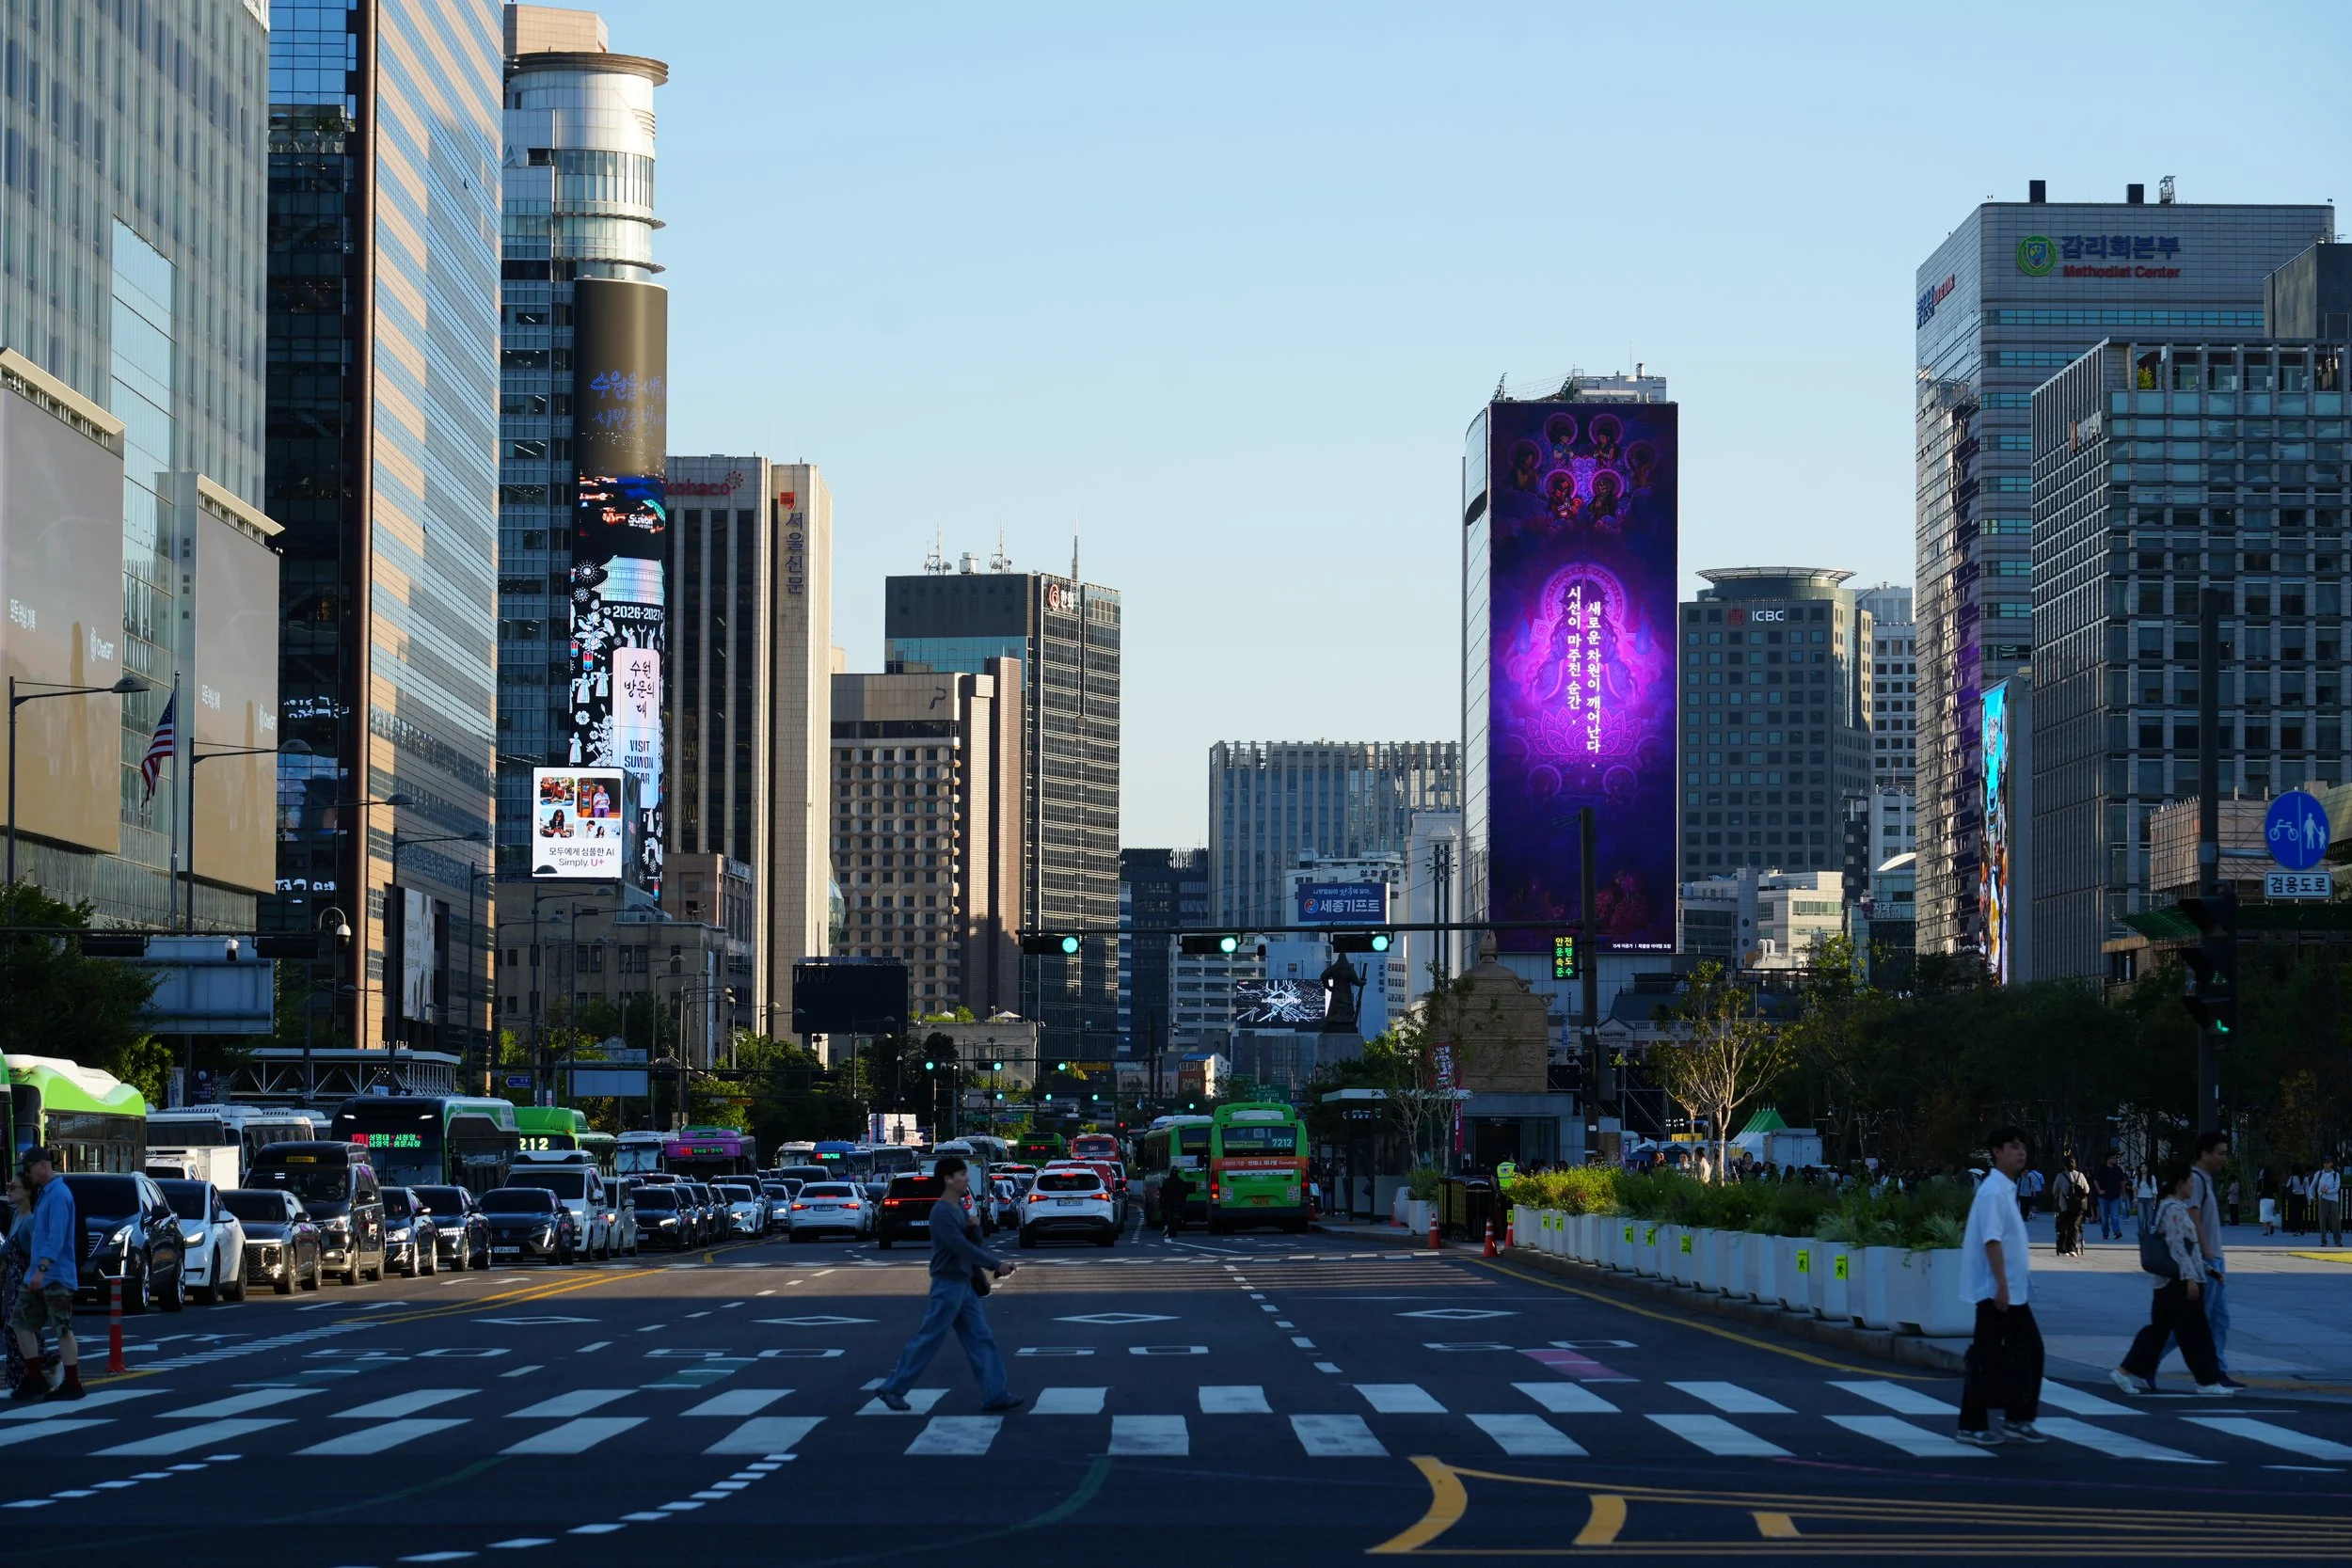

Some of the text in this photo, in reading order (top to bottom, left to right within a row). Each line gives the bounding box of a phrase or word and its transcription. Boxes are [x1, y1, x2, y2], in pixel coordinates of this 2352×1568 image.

[2061, 235, 2181, 260] 감리회본부
[2063, 265, 2181, 278] Methodist Center
[666, 479, 731, 496] kobaco
[786, 512, 804, 594] 서울신문
[1060, 590, 1074, 610] 한화
[612, 605, 660, 621] 2026-2027
[1752, 610, 1784, 622] ICBC
[1586, 601, 1601, 645] 새로운
[97, 638, 115, 660] ChatGPT
[1567, 586, 1581, 724] 시선이 마주친 순간,
[629, 660, 651, 679] 수원
[1586, 648, 1601, 692] 차원이
[624, 679, 655, 699] 방문의
[629, 739, 650, 752] VISIT
[624, 755, 654, 769] SUWON
[548, 847, 580, 857] 모두에게
[581, 847, 604, 857] 심플한
[559, 858, 604, 867] Simply. U+
[2270, 876, 2327, 894] 겸용도로
[1320, 899, 1380, 912] 세종기프트
[1874, 902, 1891, 912] 치과
[1555, 937, 1573, 946] 안전
[1555, 947, 1573, 957] 운행
[1555, 958, 1573, 966] 속도
[1555, 967, 1573, 977] 준수
[1272, 1139, 1293, 1148] 7212
